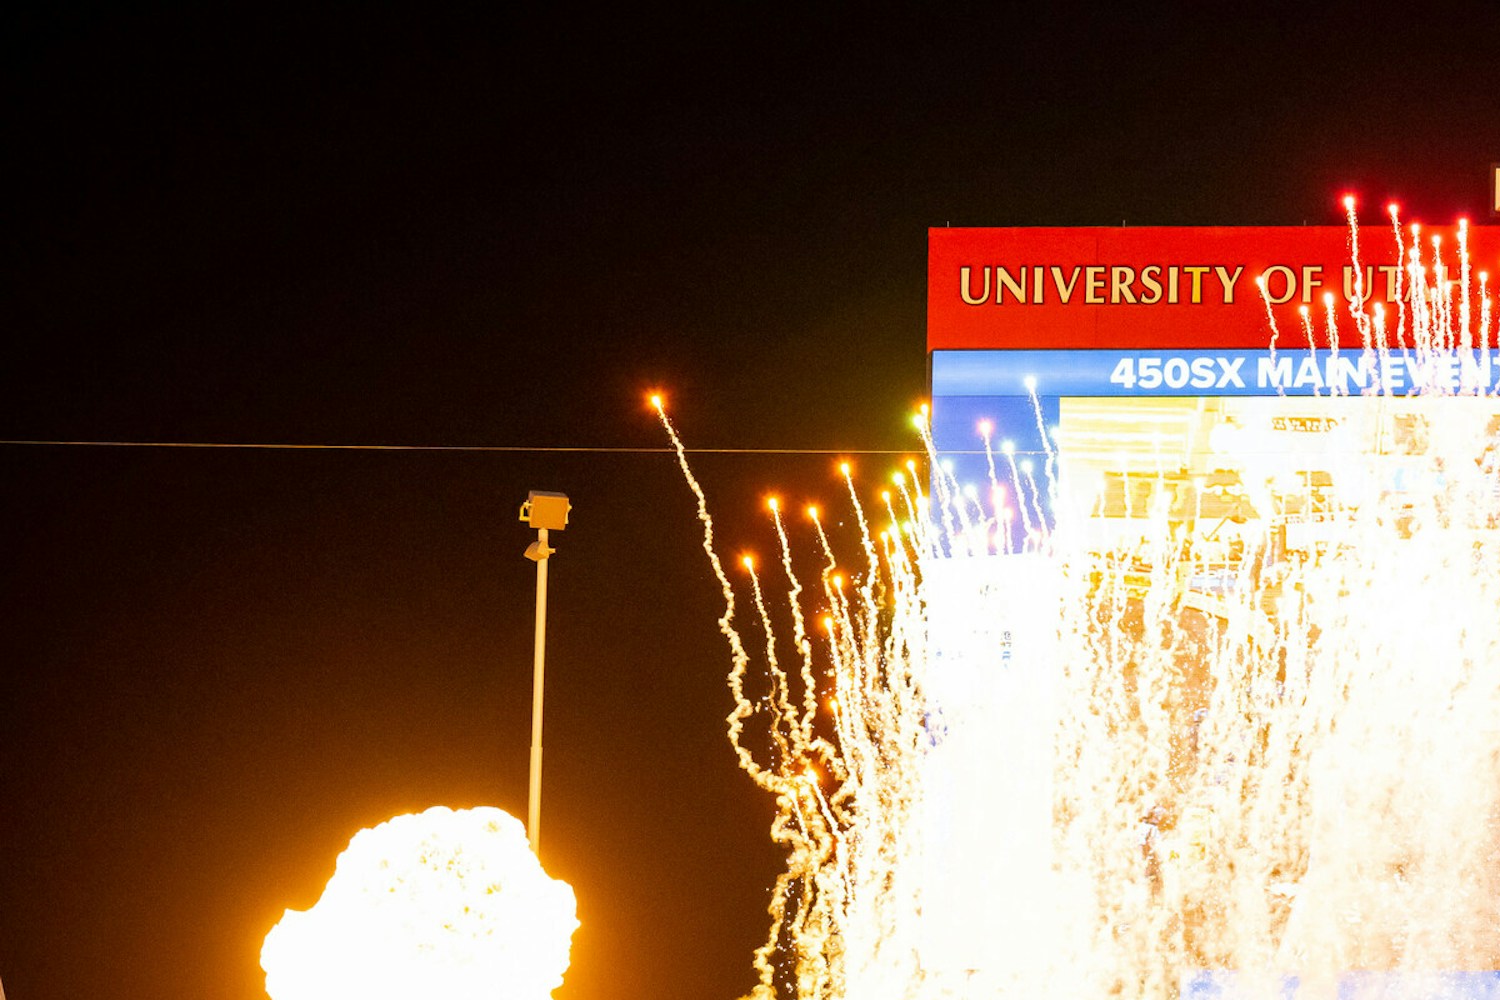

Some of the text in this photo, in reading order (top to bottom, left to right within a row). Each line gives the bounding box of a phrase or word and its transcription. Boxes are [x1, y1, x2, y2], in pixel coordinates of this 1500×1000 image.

[960, 266, 1244, 305] UNIVERSITY
[1264, 265, 1323, 304] OF
[1110, 357, 1247, 389] 450SX
[1257, 357, 1369, 388] MAIN
